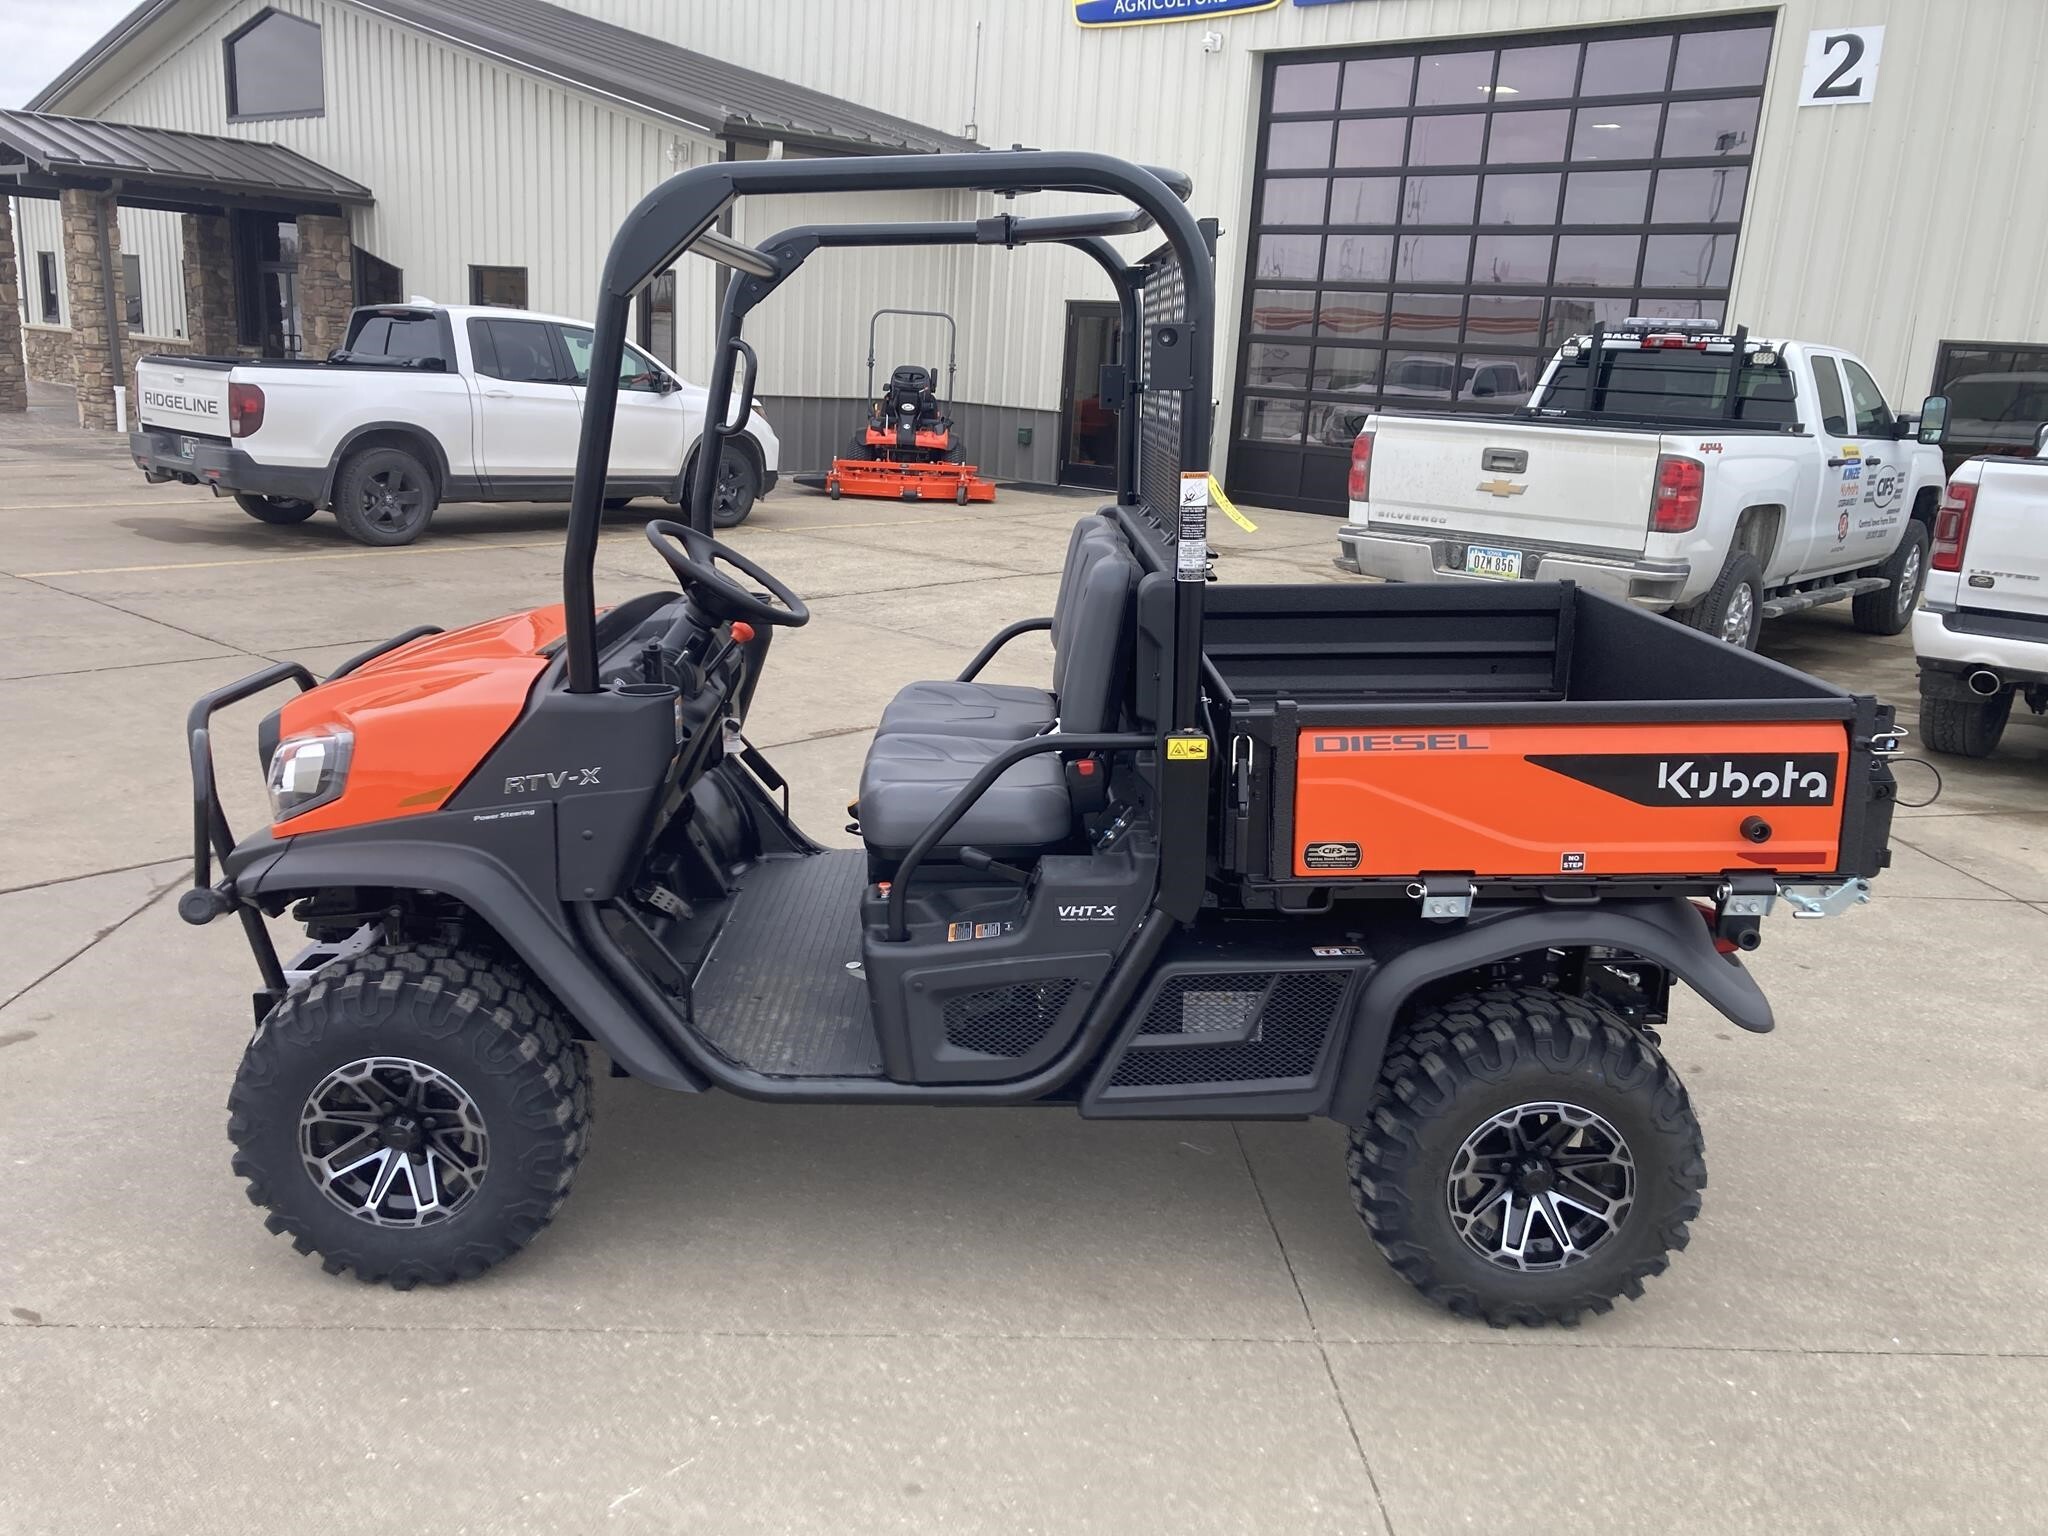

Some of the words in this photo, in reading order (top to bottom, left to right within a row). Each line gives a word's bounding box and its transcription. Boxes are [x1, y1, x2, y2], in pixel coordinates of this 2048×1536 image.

[1113, 0, 1228, 14] AGRICU
[1812, 33, 1865, 98] 2
[1602, 332, 1641, 340] BACK
[144, 391, 218, 414] RIDGELINE
[1495, 557, 1514, 572] 856
[1314, 734, 1489, 752] DIESEL
[504, 767, 602, 794] RTV-X
[1657, 761, 1828, 799] Kubota
[473, 813, 499, 822] Power
[500, 809, 536, 819] Steering
[1058, 905, 1117, 916] VHT-X
